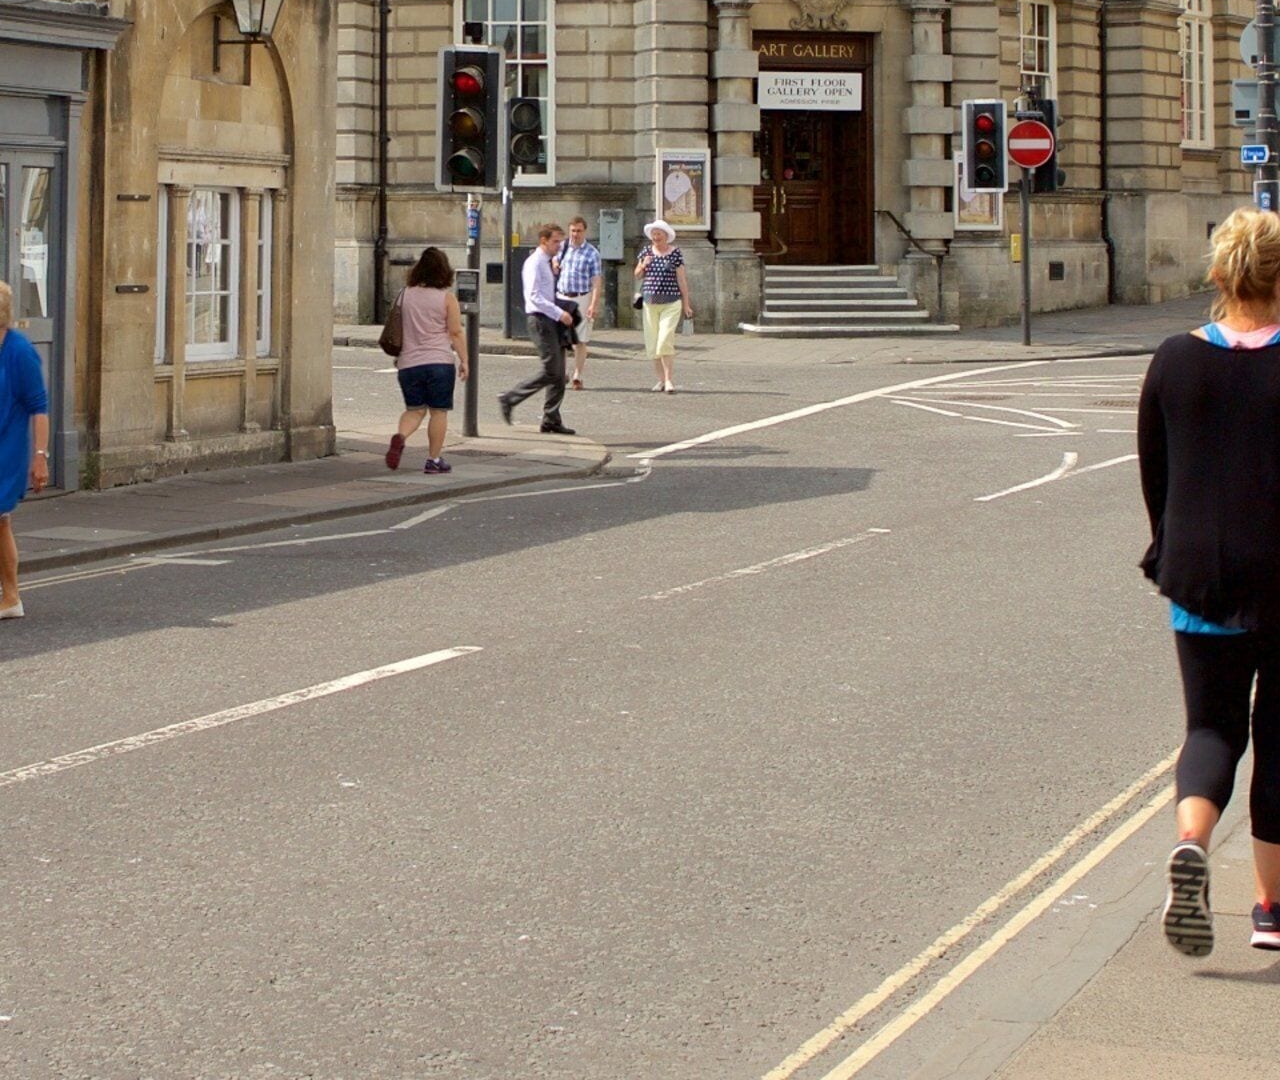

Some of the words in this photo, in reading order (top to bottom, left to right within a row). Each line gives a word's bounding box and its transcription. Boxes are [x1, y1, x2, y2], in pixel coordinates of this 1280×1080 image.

[759, 43, 787, 56] ART
[792, 44, 856, 58] GALLERY
[774, 78, 804, 87] FIRST
[811, 79, 846, 87] FLOOR
[767, 87, 819, 96] GALLERY
[824, 88, 853, 96] OPEN
